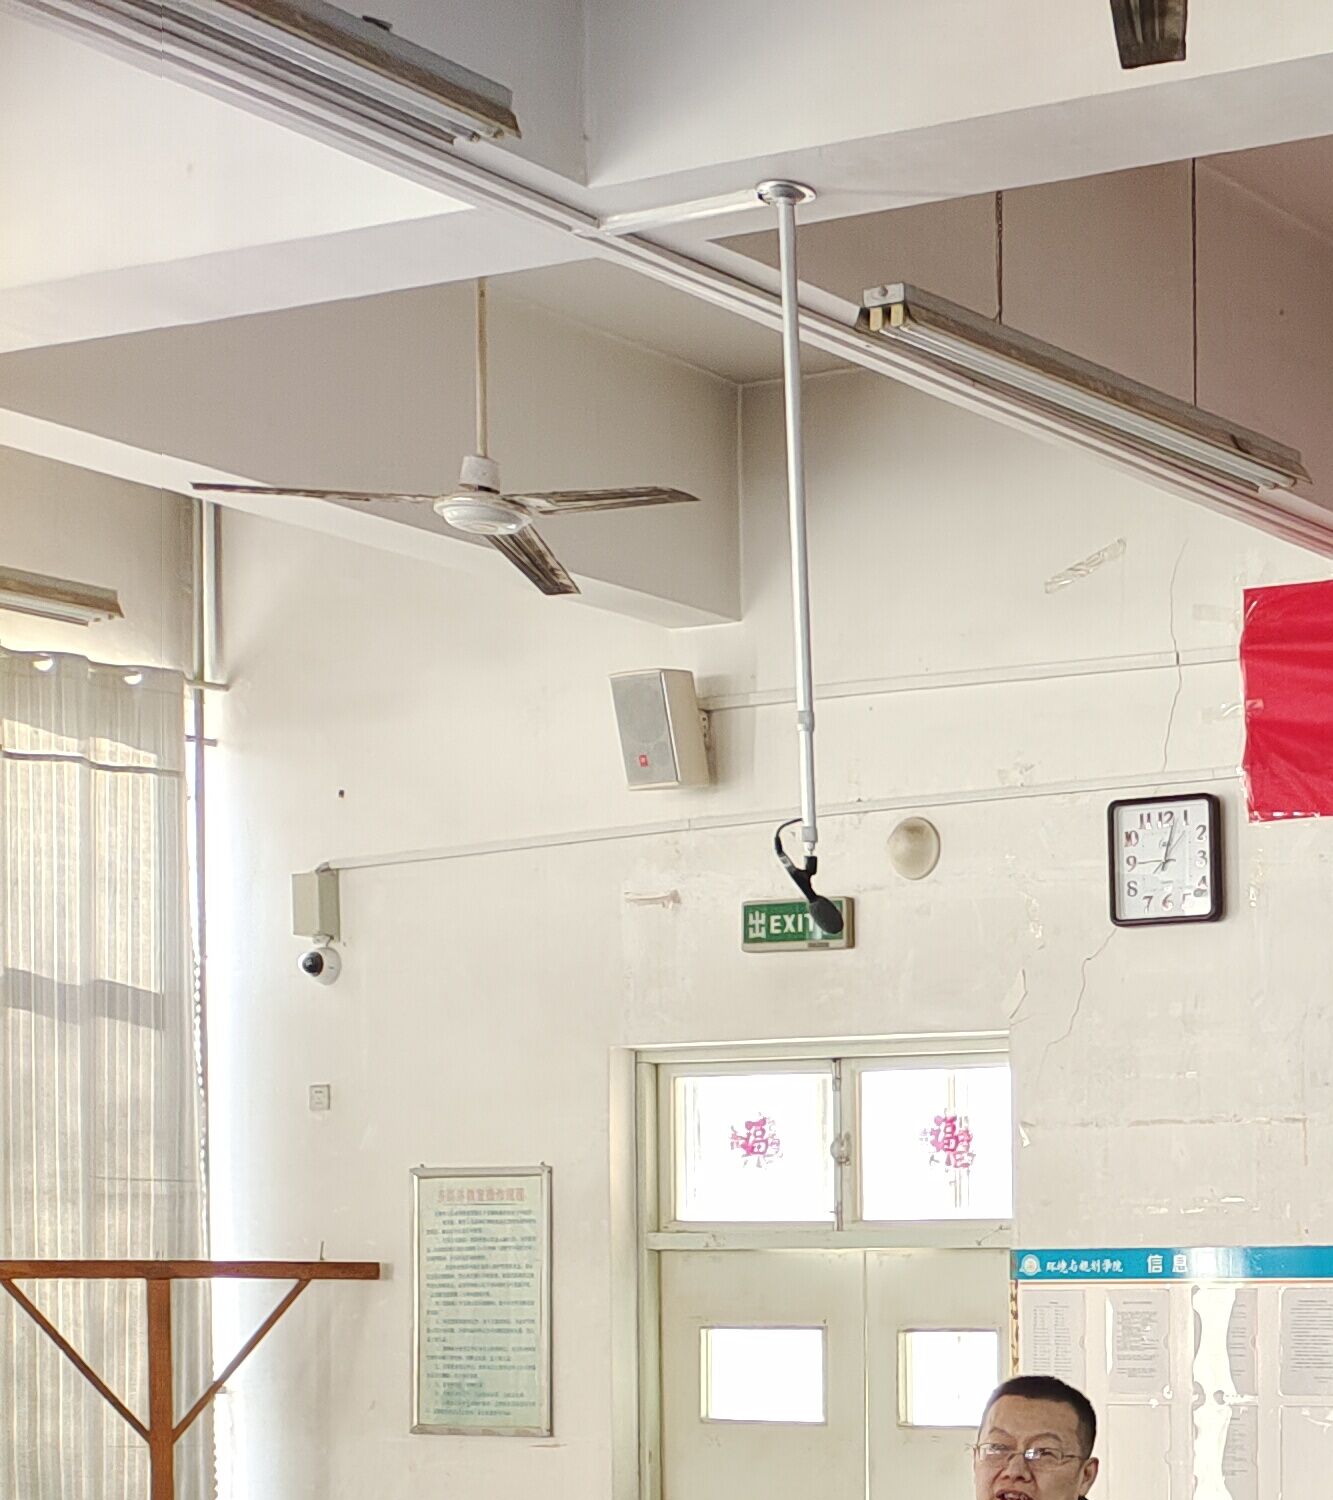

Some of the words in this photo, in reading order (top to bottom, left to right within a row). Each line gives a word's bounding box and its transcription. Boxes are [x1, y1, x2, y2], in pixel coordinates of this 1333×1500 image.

[1157, 811, 1174, 829] 12
[1124, 830, 1139, 847] 10
[1196, 824, 1208, 841] 2
[1126, 855, 1137, 872] 9
[1196, 850, 1208, 867] 3
[1127, 880, 1138, 898] 8
[1143, 895, 1153, 912] 7
[748, 910, 766, 939] 出
[770, 913, 814, 934] EXIT
